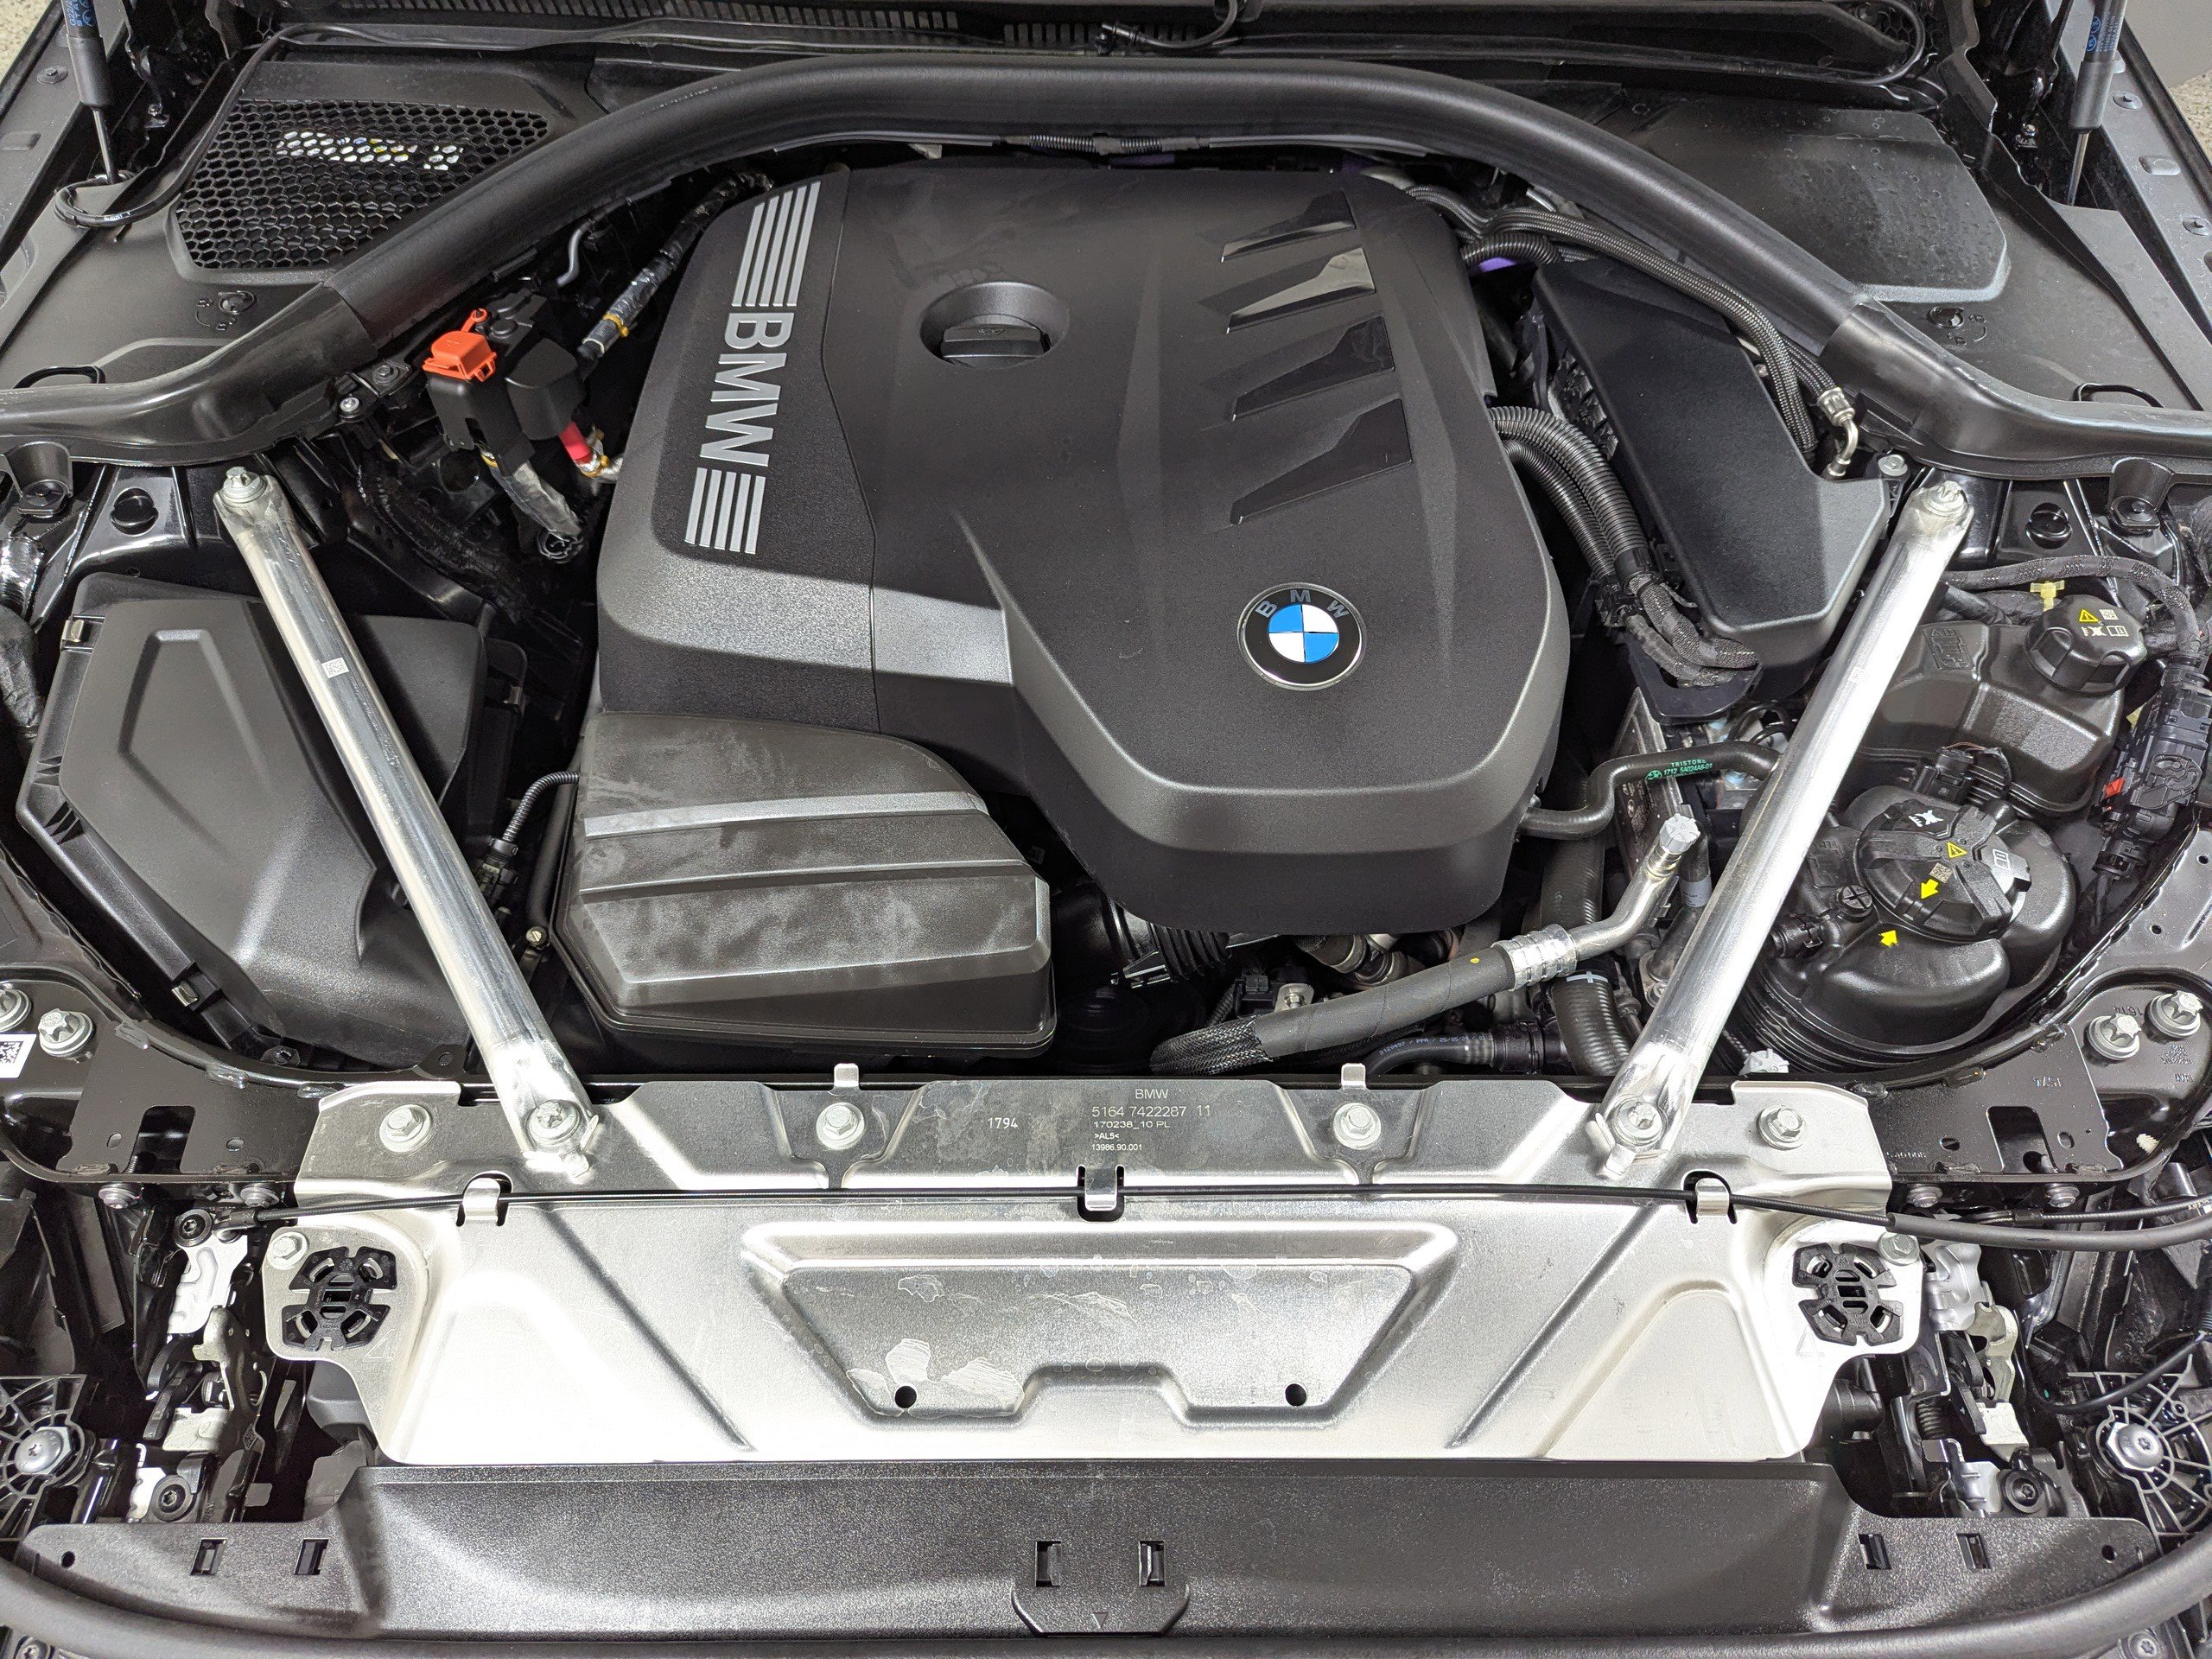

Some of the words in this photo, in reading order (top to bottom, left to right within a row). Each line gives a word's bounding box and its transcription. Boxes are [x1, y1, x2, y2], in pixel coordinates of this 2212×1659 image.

[700, 312, 794, 467] BMW
[1255, 588, 1351, 619] BMW
[1671, 759, 1707, 768] TRISTONE
[1663, 767, 1678, 776] 1712
[1135, 1088, 1169, 1100] BMW
[1091, 1105, 1125, 1117] 5164
[1128, 1105, 1187, 1117] 7422287
[1196, 1104, 1211, 1116] 11
[987, 1117, 1019, 1129] 1794
[1093, 1121, 1154, 1129] 170238_10
